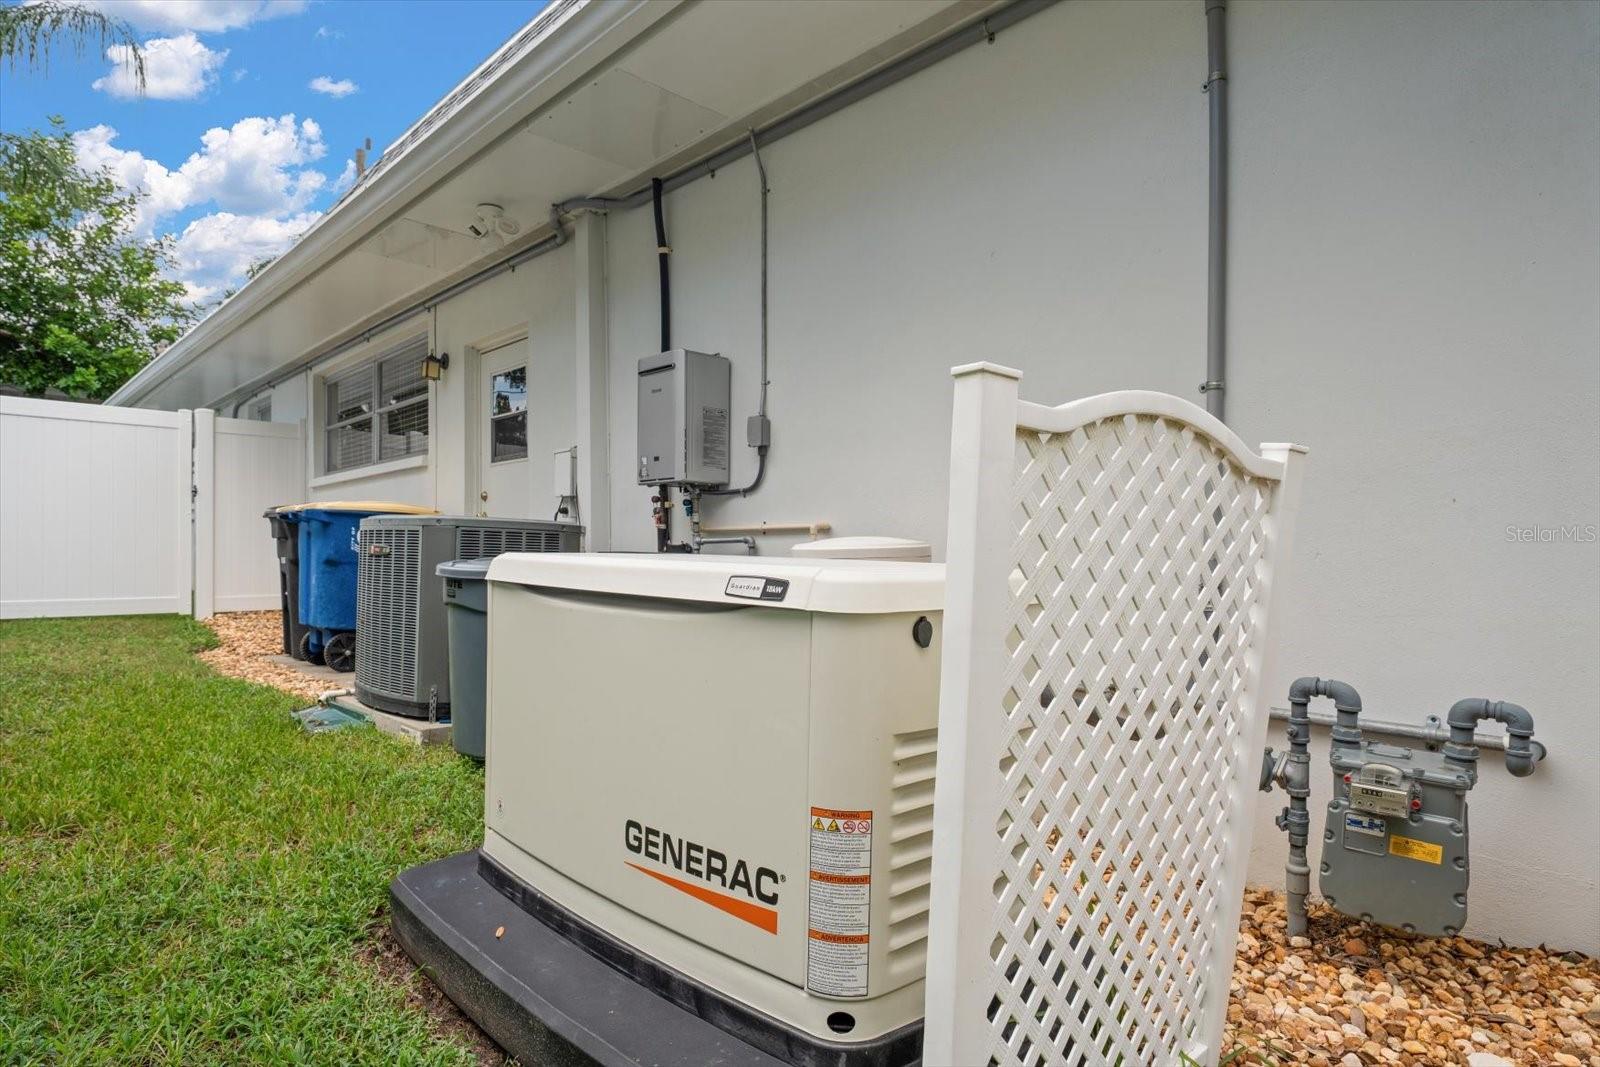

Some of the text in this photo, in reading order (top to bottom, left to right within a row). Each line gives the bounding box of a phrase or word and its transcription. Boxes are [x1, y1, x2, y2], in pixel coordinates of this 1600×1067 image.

[730, 583, 760, 591] Guardian
[831, 811, 860, 819] WARNING
[818, 874, 868, 883] AVERTISSEMENT
[820, 934, 864, 943] ADVERTENCIA
